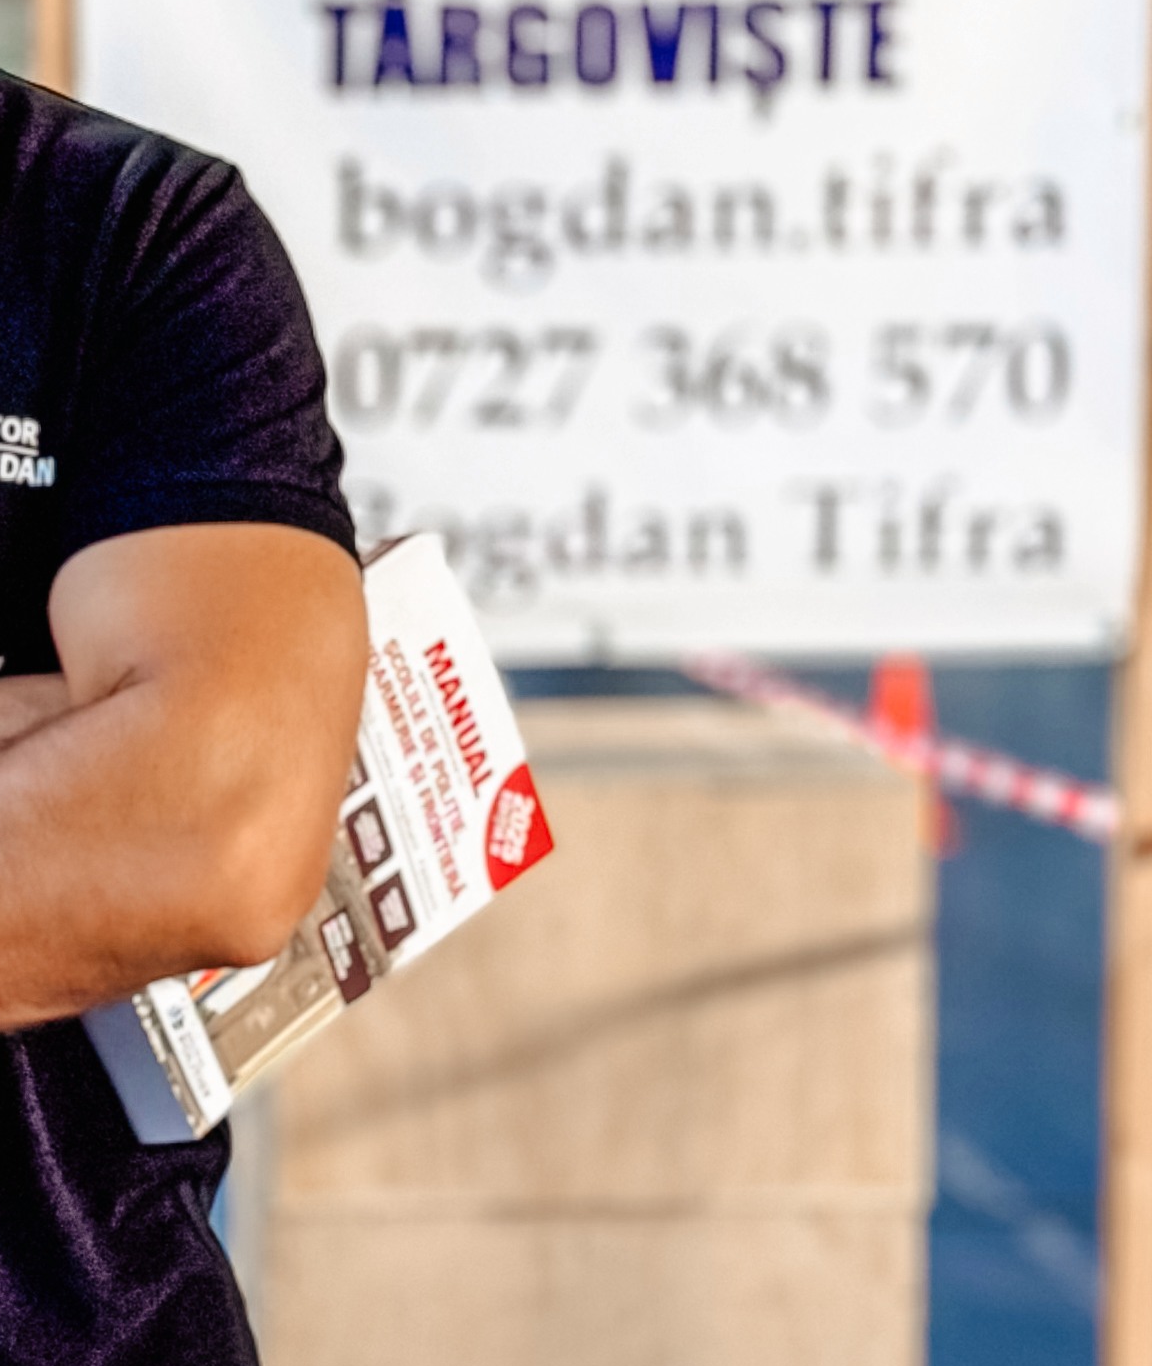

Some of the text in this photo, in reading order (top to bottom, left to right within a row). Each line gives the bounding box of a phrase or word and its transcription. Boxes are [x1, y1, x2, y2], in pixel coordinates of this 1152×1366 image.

[338, 156, 1066, 292] bogdan.tifra
[333, 322, 1073, 427] 0727 368 570
[811, 484, 1066, 574] Tifra
[424, 638, 493, 800] MANUAL
